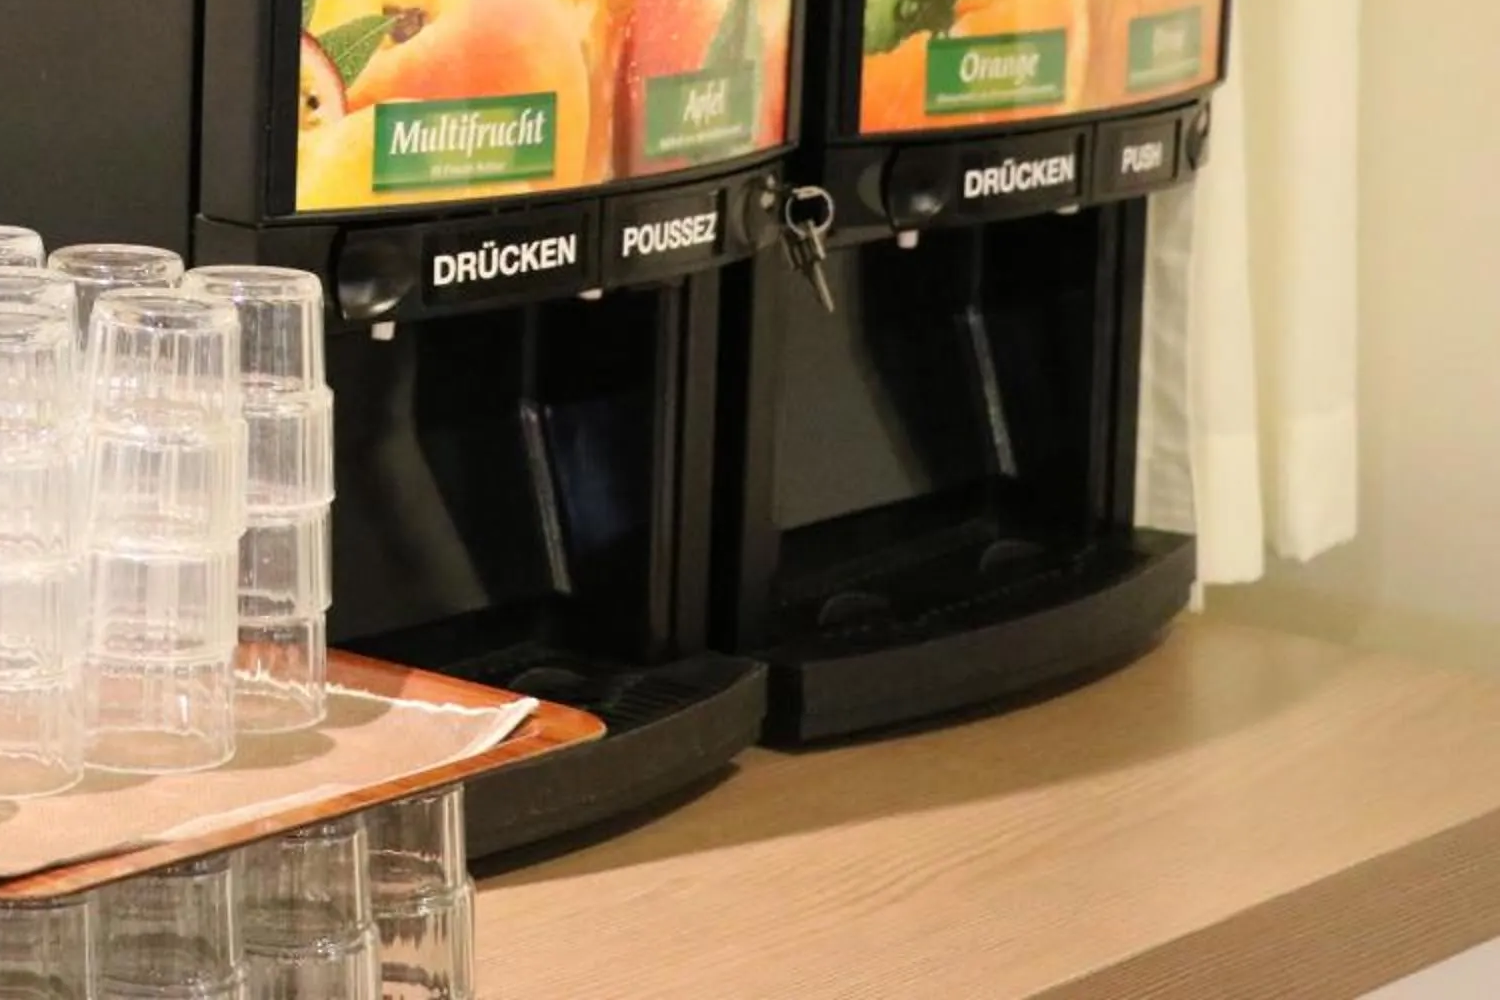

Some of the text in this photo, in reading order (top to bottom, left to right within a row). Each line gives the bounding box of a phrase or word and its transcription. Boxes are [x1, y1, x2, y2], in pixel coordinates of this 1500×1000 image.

[389, 107, 547, 158] Multifrucht
[964, 153, 1075, 198] DRÜCKEN
[1121, 142, 1162, 173] PUSH
[622, 211, 718, 257] POUSSEZ
[433, 234, 578, 287] DRÜCKEN
